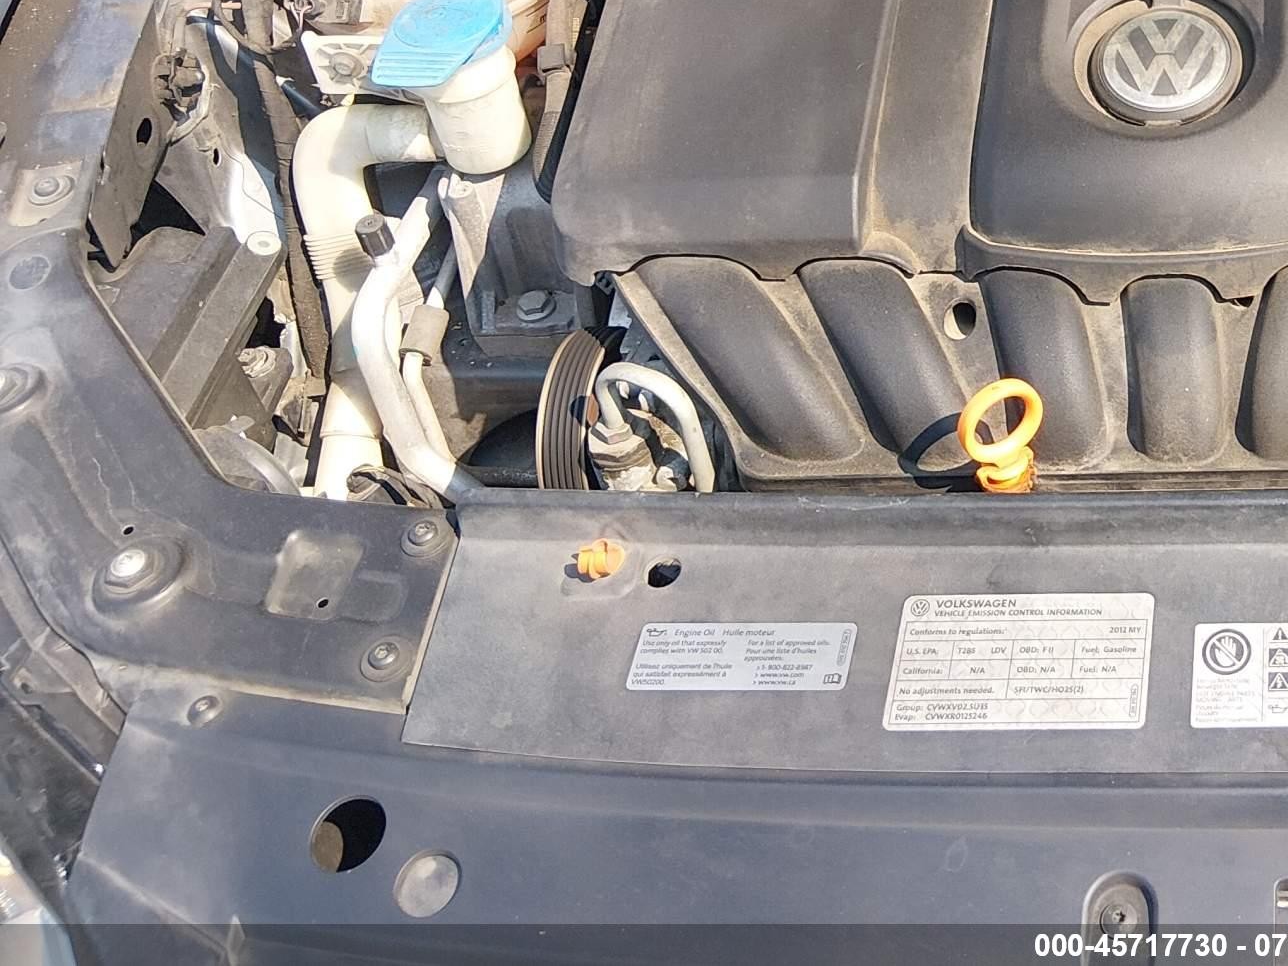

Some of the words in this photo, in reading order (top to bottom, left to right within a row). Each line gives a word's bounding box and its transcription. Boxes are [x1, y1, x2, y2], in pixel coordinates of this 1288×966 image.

[936, 599, 1017, 609] VOLKSWAGEN
[934, 609, 965, 617] VEHICLE
[674, 628, 701, 638] Engine
[704, 628, 715, 636] Oil
[722, 628, 743, 636] Huile
[910, 627, 946, 636] Conforms
[1109, 626, 1127, 634] 2012
[970, 666, 985, 674] N/A
[1101, 665, 1117, 673] N/A
[899, 687, 910, 695] No
[912, 687, 961, 696] adjustments
